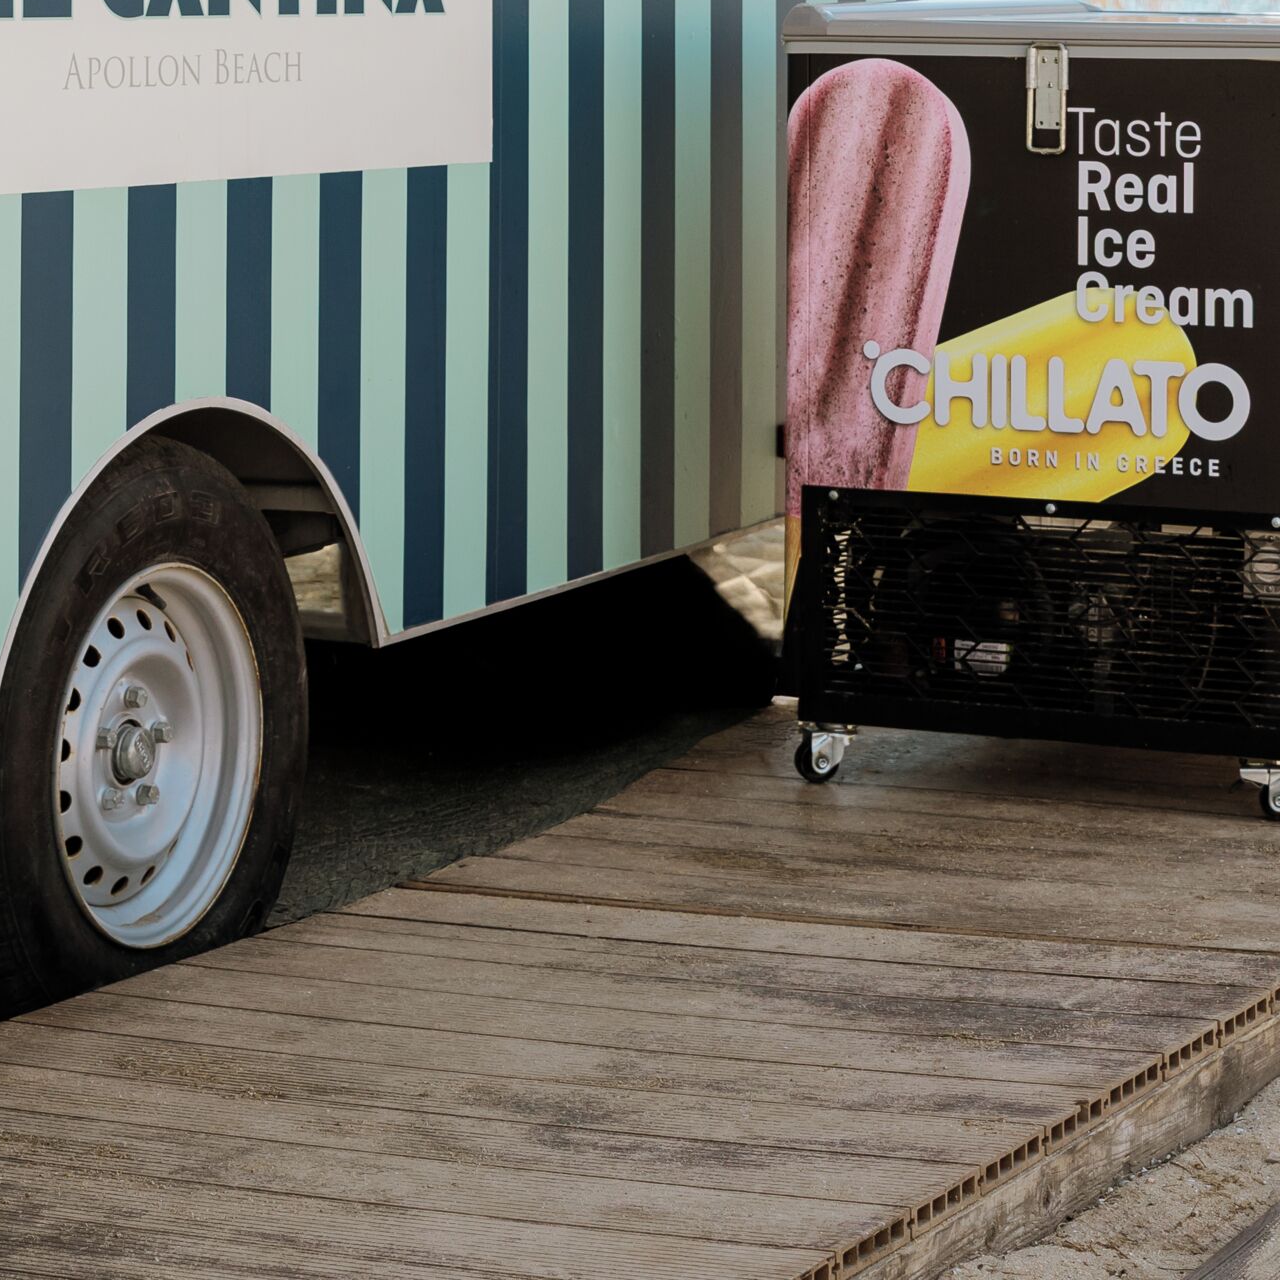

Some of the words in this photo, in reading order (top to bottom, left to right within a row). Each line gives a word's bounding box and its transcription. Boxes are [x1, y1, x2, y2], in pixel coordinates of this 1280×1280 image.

[62, 51, 202, 90] APOLLON
[214, 48, 303, 85] BEACH
[1067, 107, 1202, 158] Taste
[1077, 160, 1195, 214] Real
[1077, 215, 1156, 269] Ice
[1075, 270, 1254, 328] Cream
[863, 340, 1251, 441] CHILLATO
[991, 447, 1058, 469] BORN
[1075, 451, 1099, 471] IN
[1117, 455, 1221, 478] GREECE
